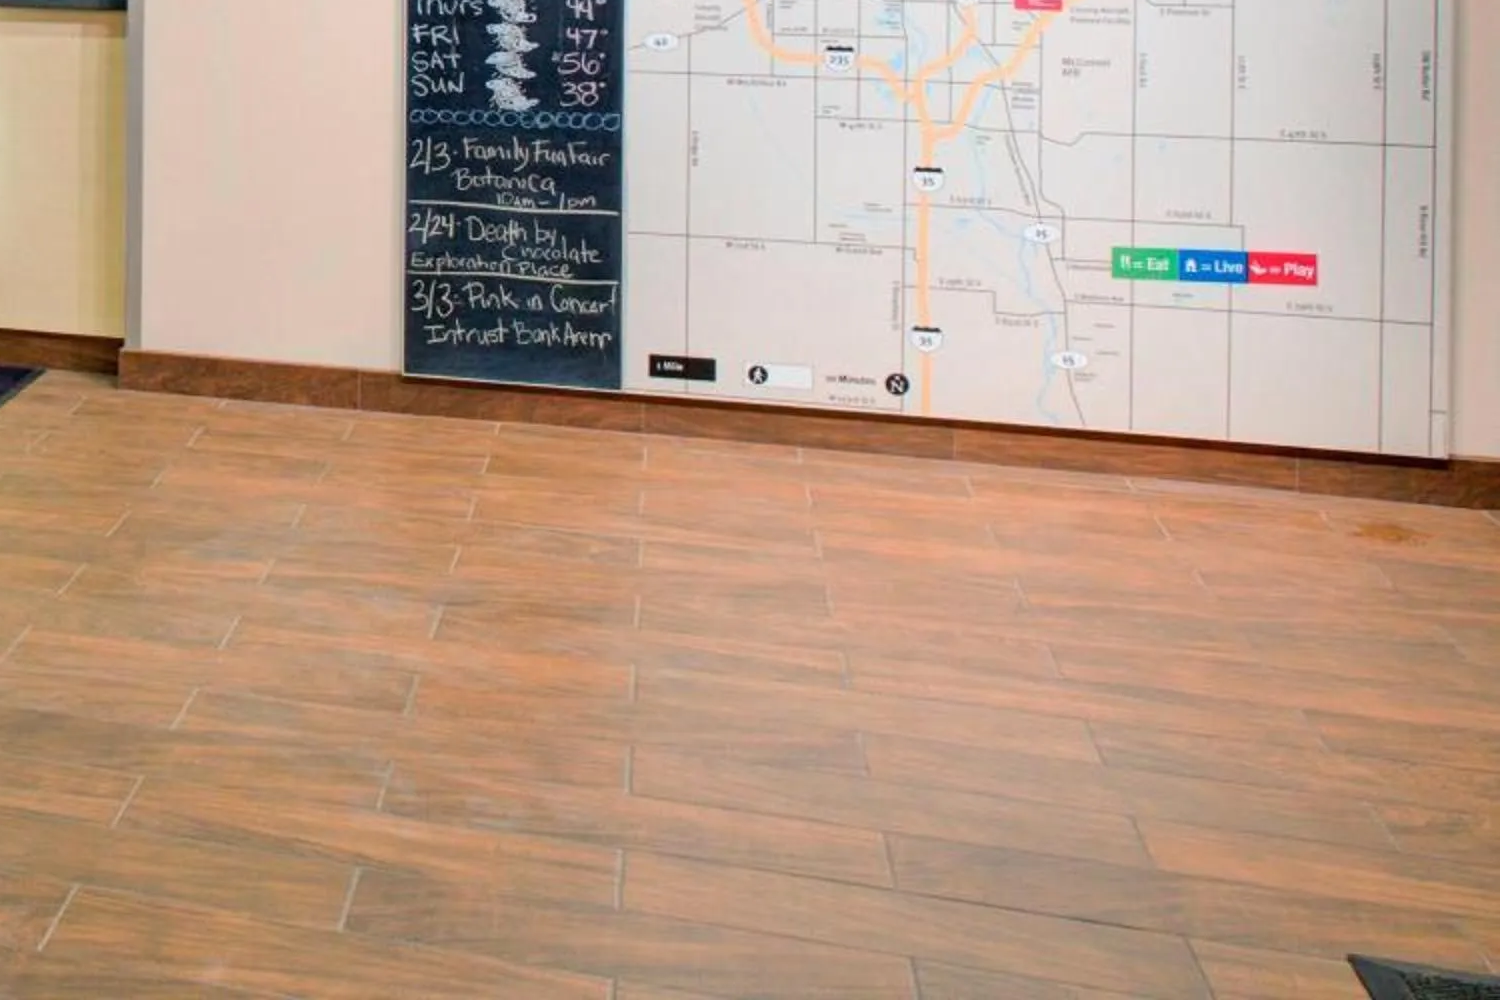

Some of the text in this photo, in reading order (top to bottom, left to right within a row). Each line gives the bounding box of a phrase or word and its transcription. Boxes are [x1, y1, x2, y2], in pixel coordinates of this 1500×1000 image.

[411, 23, 461, 46] FRI
[411, 50, 462, 73] SAT
[411, 71, 465, 97] SUN
[463, 136, 529, 172] Family
[465, 215, 528, 246] Death
[534, 217, 557, 247] by
[518, 260, 576, 279] Place
[1146, 257, 1170, 272] Eat
[1214, 258, 1245, 274] Live
[1284, 262, 1315, 280] Play
[512, 319, 560, 346] Bank
